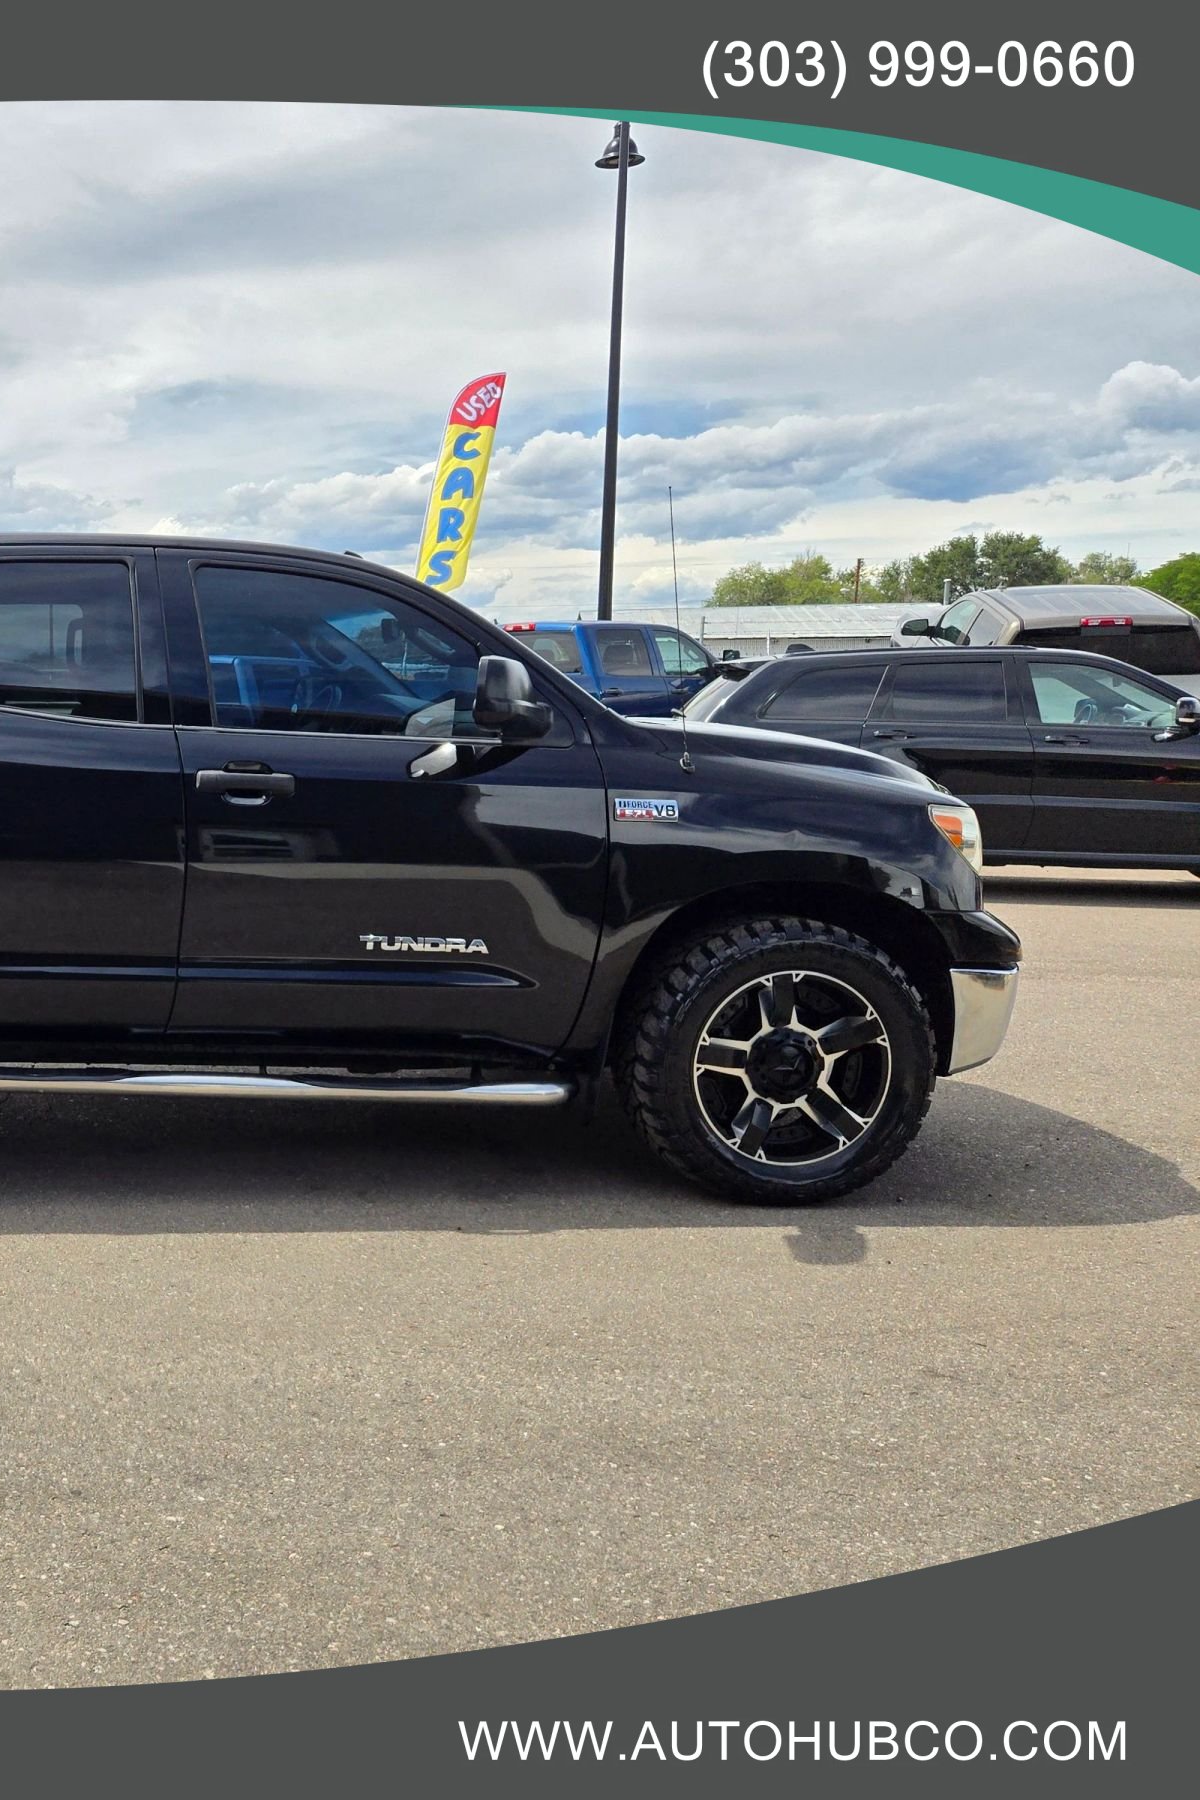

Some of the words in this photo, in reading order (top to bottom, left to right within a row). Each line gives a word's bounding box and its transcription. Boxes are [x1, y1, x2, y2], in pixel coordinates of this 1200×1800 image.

[456, 382, 502, 422] USED
[424, 431, 481, 586] CARS
[654, 804, 676, 817] V8
[359, 934, 489, 954] TUNDRA
